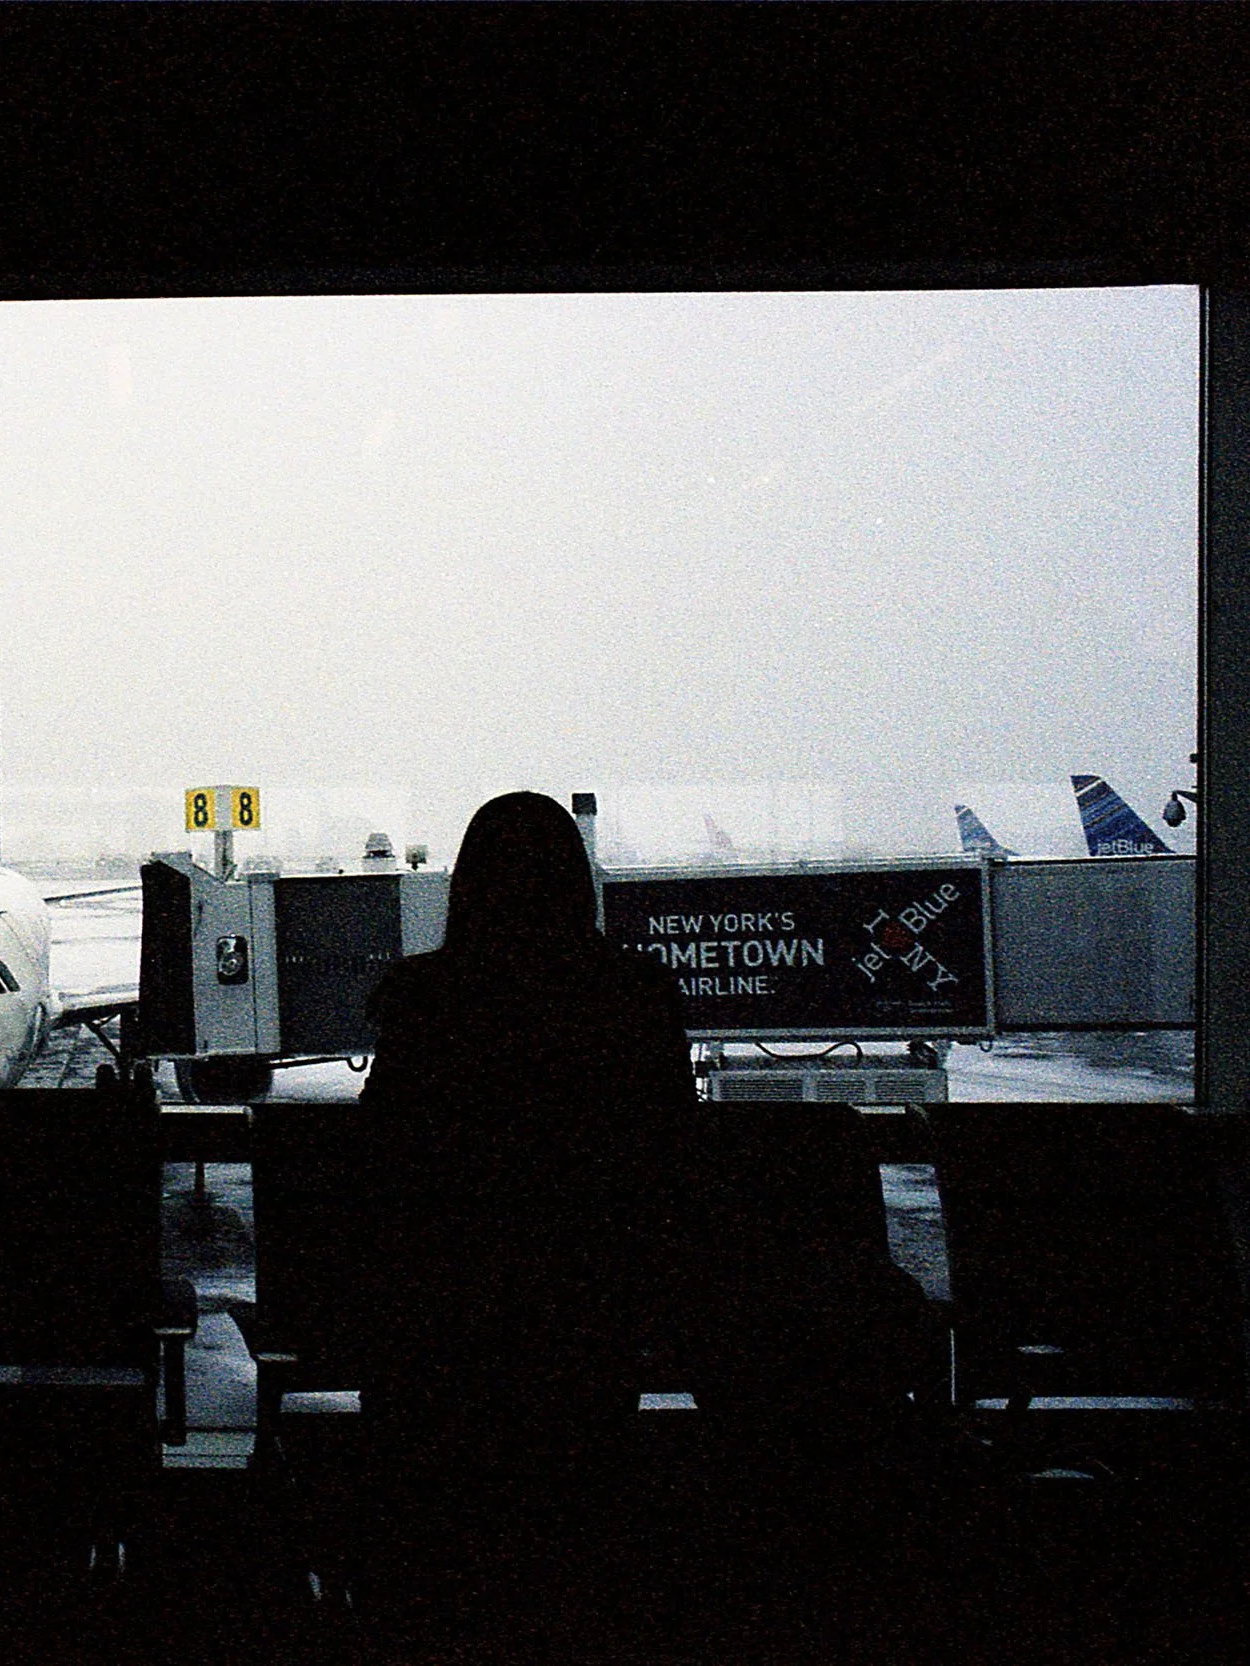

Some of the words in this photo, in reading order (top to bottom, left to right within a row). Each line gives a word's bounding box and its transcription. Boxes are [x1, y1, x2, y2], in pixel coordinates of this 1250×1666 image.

[193, 793, 208, 827] 8
[240, 792, 253, 825] 8
[1096, 839, 1154, 856] jetBlue
[648, 915, 703, 935] NEW
[709, 912, 796, 933] YORK'S
[851, 942, 892, 984] jet
[897, 883, 960, 935] Blue
[622, 938, 825, 968] OMETOWN
[862, 908, 890, 934] I
[899, 941, 959, 992] NY
